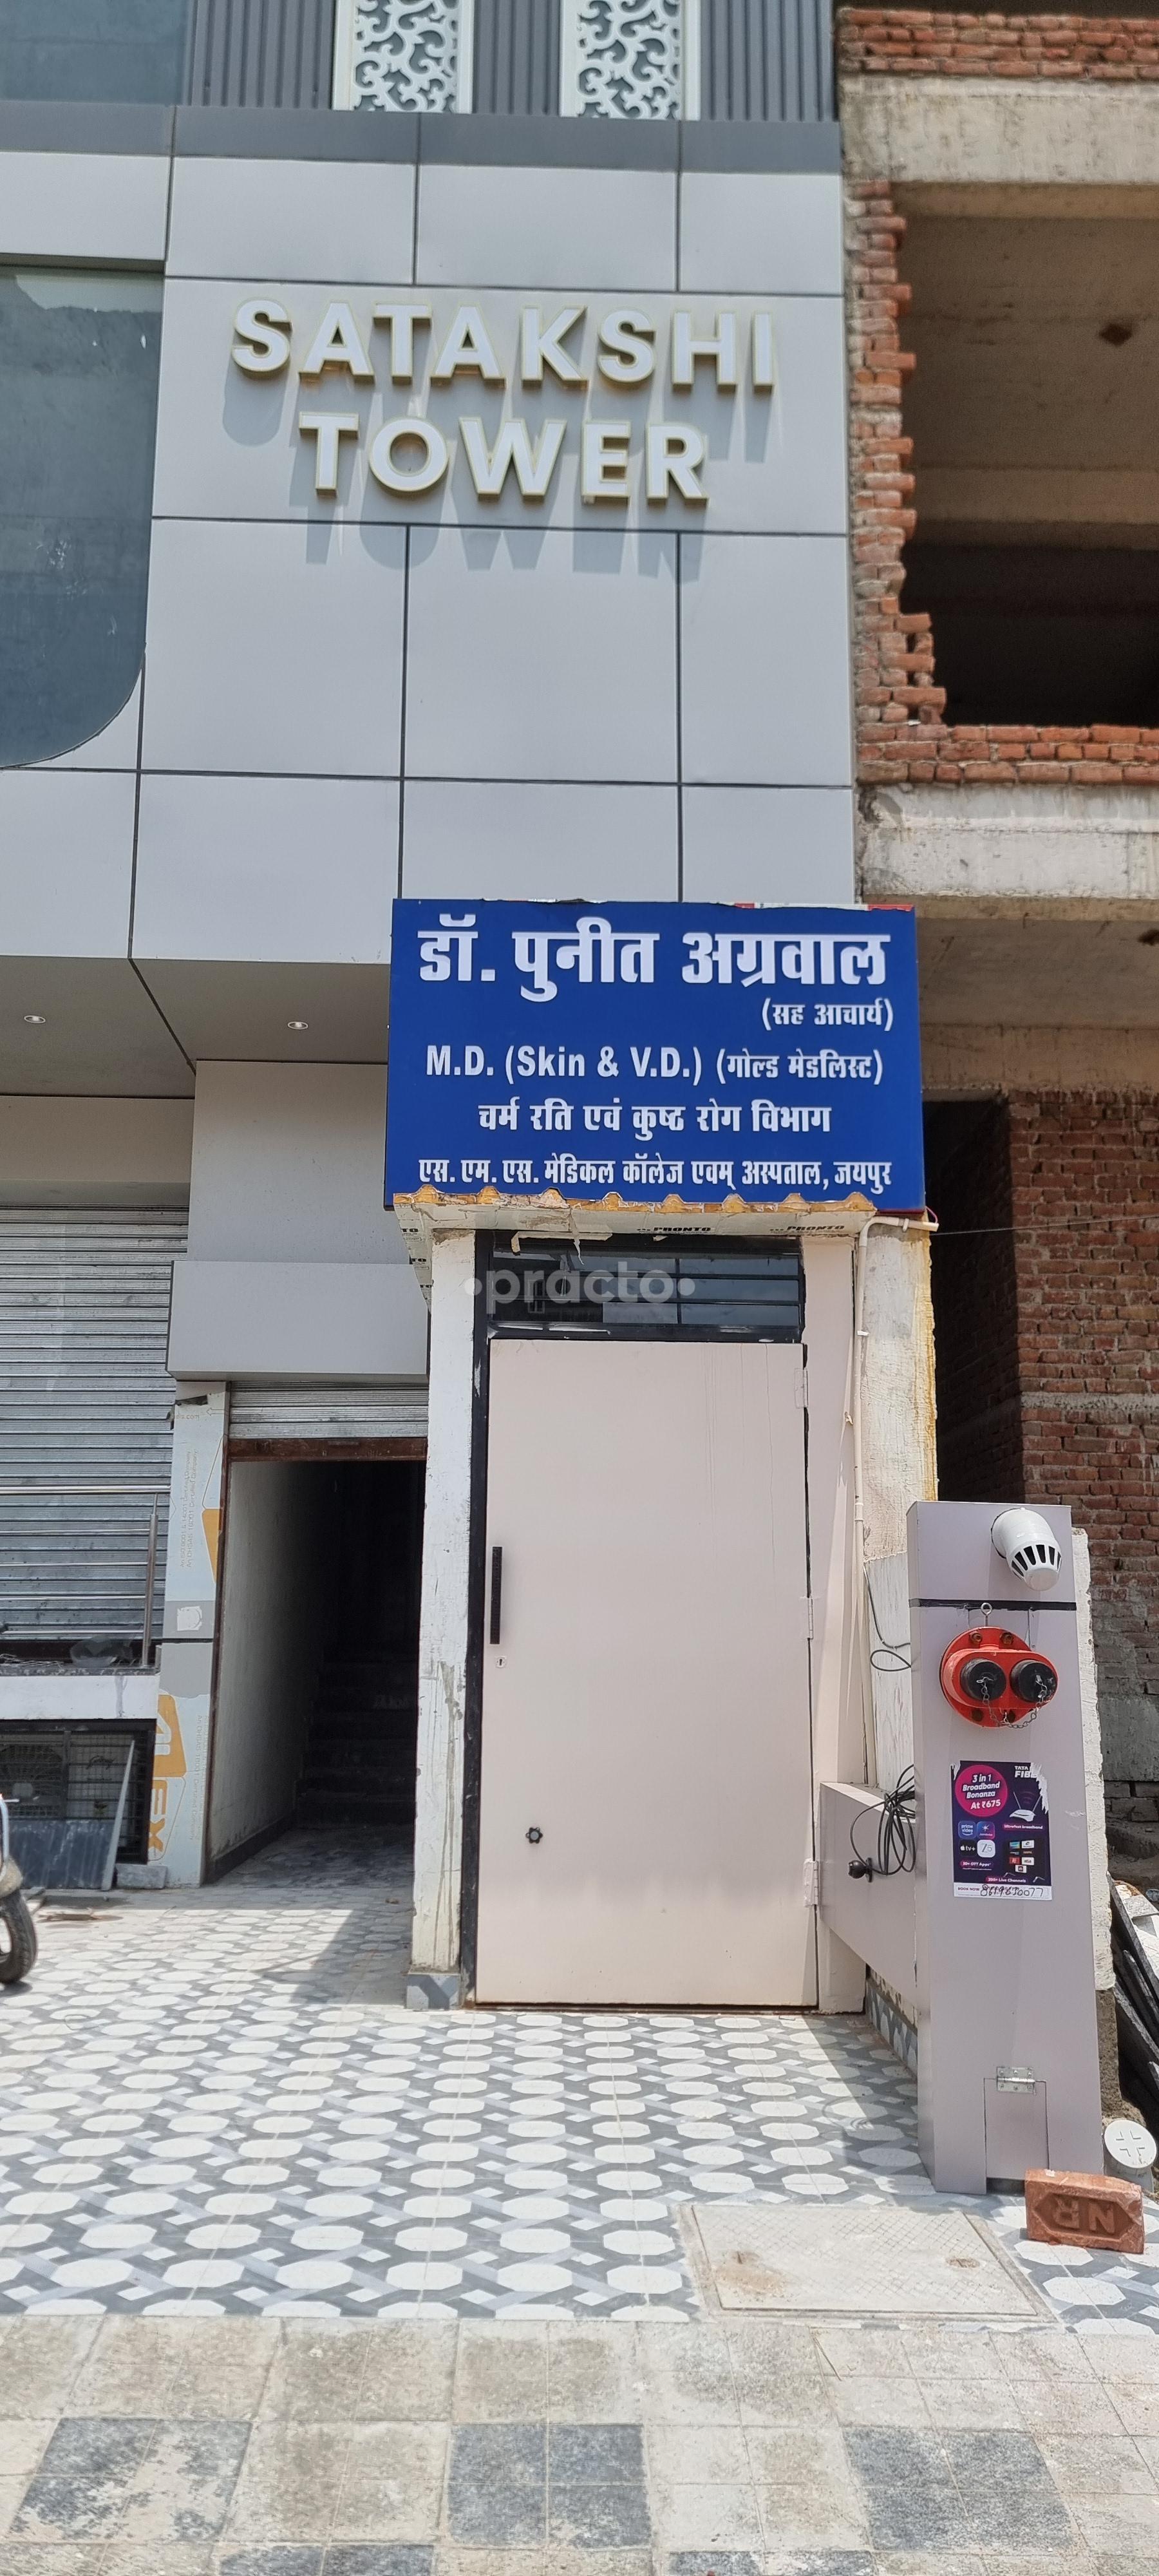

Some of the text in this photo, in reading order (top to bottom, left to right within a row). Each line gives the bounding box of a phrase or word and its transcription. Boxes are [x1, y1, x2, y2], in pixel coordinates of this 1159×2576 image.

[231, 298, 776, 392] SATAKSHI
[299, 411, 709, 506] TOWER
[417, 914, 892, 1002] डॉ. पुनीत अग्रवाल
[762, 998, 893, 1032] (सह आचार्य)
[426, 1045, 883, 1086] M.D. (Skin & V.D.) (गोल्ड मेडलिस्ट)
[478, 1096, 832, 1141] चर्म रति एवं कुष्ठ रोग विभाग
[419, 1152, 892, 1195] एस. एम. एस. मेडिकल कॉलेज एवम् अस्पताल, जयपुर
[963, 1781, 1001, 1791] Broadband
[979, 1774, 986, 1782] in
[970, 1801, 980, 1810] At
